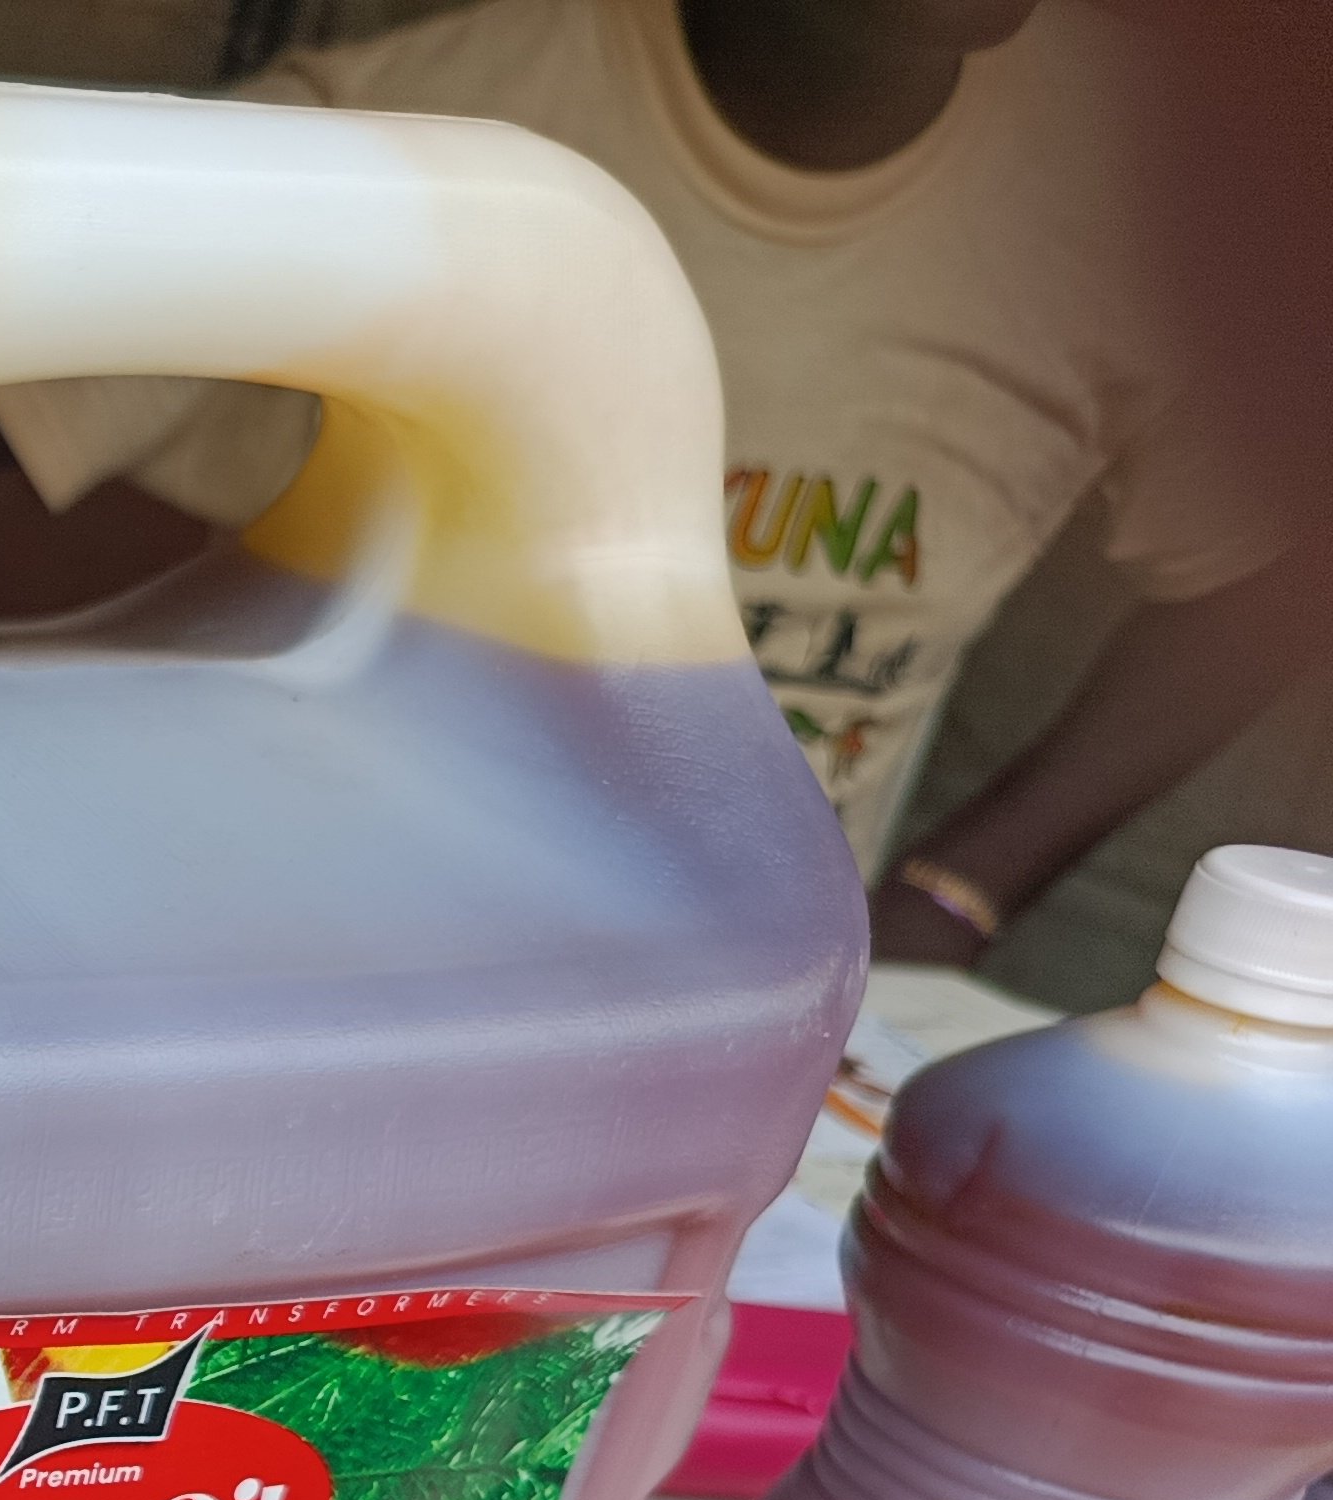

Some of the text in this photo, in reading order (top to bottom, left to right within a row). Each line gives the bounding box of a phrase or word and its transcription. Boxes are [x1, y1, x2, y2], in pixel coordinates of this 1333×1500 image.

[133, 1288, 554, 1333] TRANSFORMERS
[56, 1387, 164, 1429] P.F.T
[19, 1463, 143, 1489] Premium
